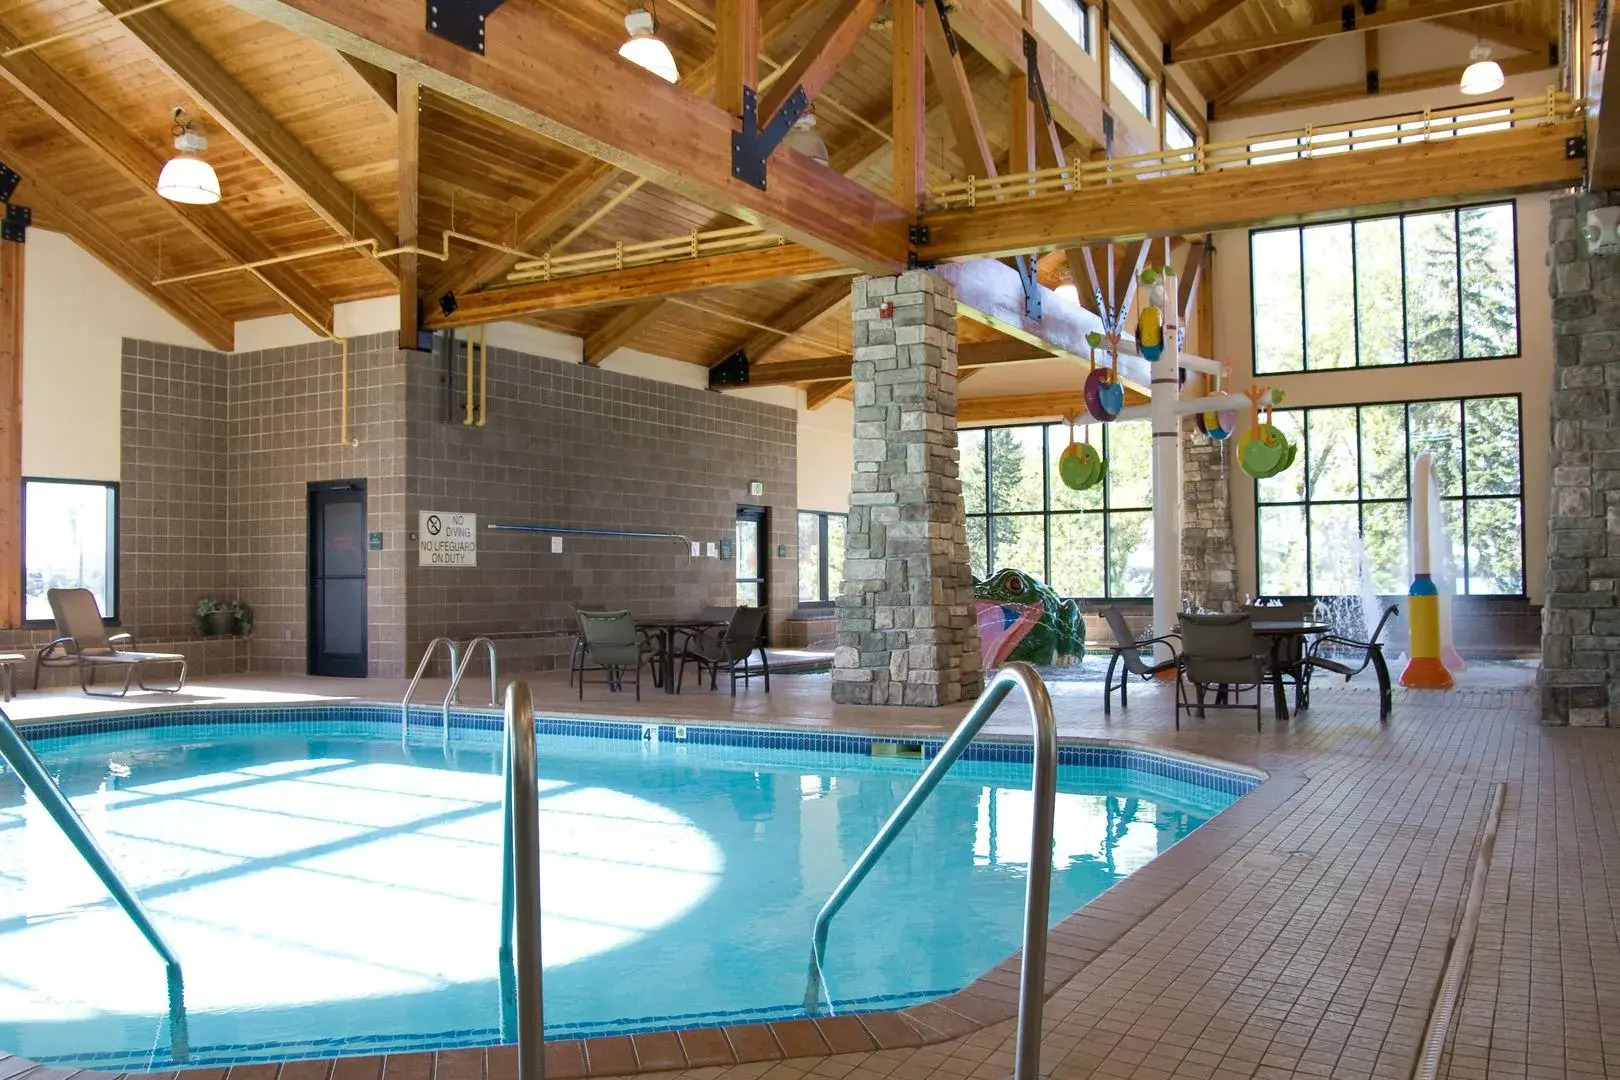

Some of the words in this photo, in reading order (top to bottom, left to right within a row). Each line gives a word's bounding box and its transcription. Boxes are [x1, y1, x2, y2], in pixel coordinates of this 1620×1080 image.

[453, 515, 464, 525] NO
[446, 527, 471, 537] DIVING
[421, 541, 432, 551] NO
[435, 541, 475, 552] LIFEGUARD
[432, 553, 443, 563] ON
[445, 553, 465, 563] DUTY
[643, 727, 652, 741] 4
